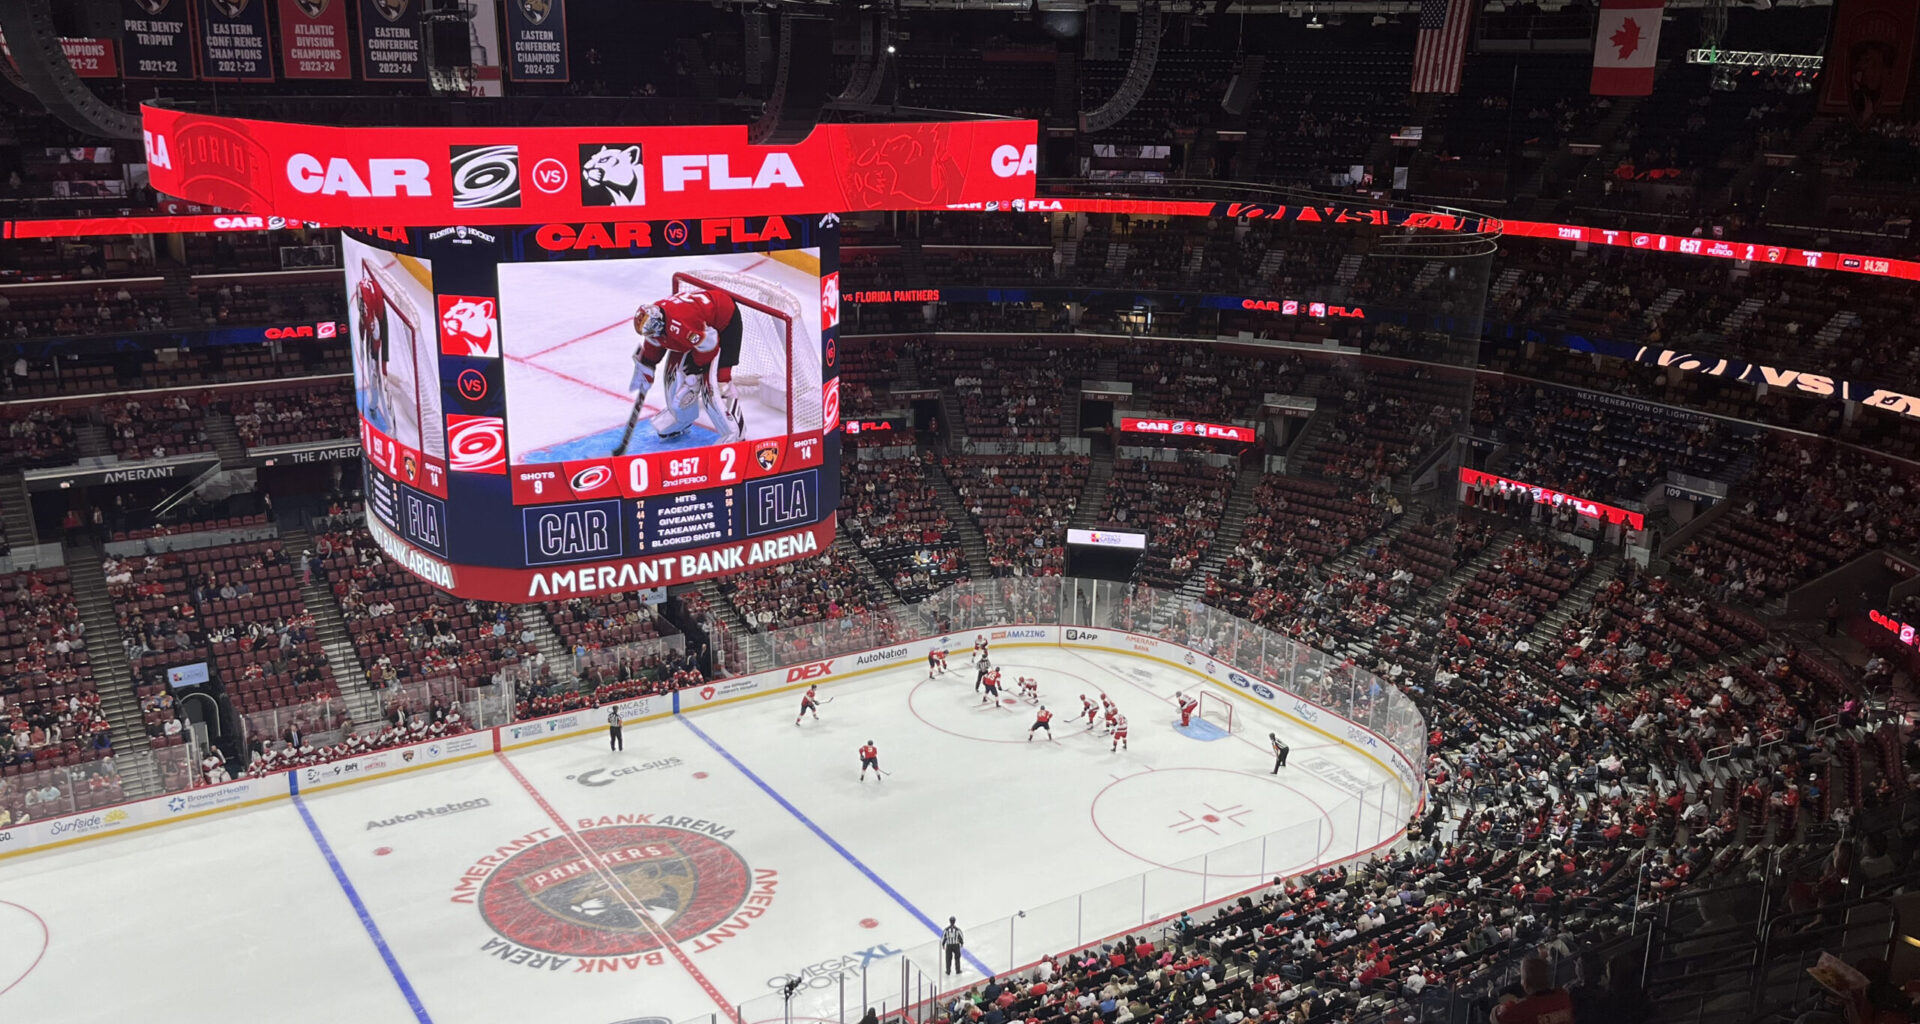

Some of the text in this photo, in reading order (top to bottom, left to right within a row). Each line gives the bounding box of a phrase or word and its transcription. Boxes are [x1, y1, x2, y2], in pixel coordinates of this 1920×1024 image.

[125, 20, 183, 33] PRESDENTS'
[213, 24, 253, 35] EASTERN
[295, 25, 335, 36] ATLANTIC
[375, 27, 411, 39] EASTERN
[137, 34, 174, 46] TROPHY
[296, 37, 335, 48] DIVISION
[521, 31, 554, 41] EASTERN
[61, 45, 104, 56] AMPIONS
[368, 39, 419, 51] CONFERENCE
[515, 42, 561, 52] CONFERENCE
[209, 48, 262, 60] CHAMPIONS
[291, 49, 342, 60] CHAMPIONS
[371, 51, 418, 62] CHAMPIONS
[518, 53, 560, 63] CHAMPIONS
[69, 58, 98, 69] 21-22
[139, 60, 178, 73] 2021-22
[300, 61, 335, 72] 2023-24
[378, 63, 412, 74] 2023-24
[525, 64, 555, 75] 2024-25
[991, 144, 1038, 178] CA
[286, 152, 804, 197] CAR VS FLA
[1028, 200, 1062, 210] FLA
[213, 217, 263, 228] CAR
[429, 227, 457, 240] FLORIDA
[467, 227, 496, 243] HOCKEY
[536, 216, 792, 251] CAR VS FLA
[1659, 236, 1667, 250] 0
[1679, 240, 1702, 253] 9:57
[1706, 248, 1733, 257] PERIOD
[1745, 246, 1754, 260] 2
[1806, 256, 1816, 268] 14
[842, 289, 940, 303] VS FLORIDA PANTHERS
[1241, 299, 1365, 318] CAR FLA
[264, 326, 313, 340] CAR
[463, 381, 482, 391] VS
[1759, 365, 1835, 396] VS
[1577, 392, 1597, 401] NEXT
[1599, 397, 1650, 412] GENERATION
[1652, 406, 1664, 414] OF
[1666, 409, 1690, 420] LIGHT
[861, 421, 891, 431] FLA
[1137, 421, 1239, 438] CAR FLA
[793, 437, 818, 448] SHOTS
[292, 450, 316, 464] THE
[319, 446, 361, 462] AMERA
[387, 441, 397, 476] 2
[801, 447, 811, 460] 14
[670, 457, 700, 476] 9:57
[720, 447, 736, 481] 2
[104, 466, 175, 484] AMERANT
[520, 471, 556, 481] SHOTS
[630, 458, 649, 492] 0
[662, 475, 707, 488] 2nd PERIOD
[534, 480, 543, 494] 9
[1666, 487, 1681, 498] 109
[675, 494, 697, 503] HITS
[758, 480, 808, 526] FLA
[658, 505, 705, 516] FACEOFFS
[706, 502, 714, 510] %
[407, 495, 440, 548] FLA
[659, 512, 714, 526] GIVEAWAYS
[539, 509, 608, 556] CAR
[658, 522, 716, 536] TAKEAWAYS
[652, 535, 693, 548] BLOCKED
[692, 530, 721, 542] SHOTS
[384, 532, 456, 590] BANK ARENA
[529, 530, 817, 597] AMERANT BANK ARENA
[1869, 609, 1899, 634] CAR
[1006, 630, 1046, 639] AMAZING
[1125, 634, 1158, 648] AMERANT
[1133, 644, 1150, 653] BANK
[856, 646, 908, 666] AutoNation
[786, 660, 835, 683] DEX
[1230, 674, 1249, 688] Ford
[1254, 686, 1273, 699] Ford
[607, 698, 649, 713] CMCAST
[620, 706, 650, 719] SINESS
[1366, 737, 1378, 748] XL
[610, 756, 682, 777] CELSIUS
[187, 784, 249, 802] Broward Health
[365, 796, 491, 831] AutoNation
[51, 815, 101, 836] Surfside
[450, 813, 738, 904] AMERANT BANK ARENA
[534, 845, 663, 887] PANTHERS
[693, 867, 779, 954] AMERANT
[480, 936, 665, 973] ARENA BANK
[766, 942, 903, 990] OMEGA XL
[775, 964, 861, 1001] SPORT
